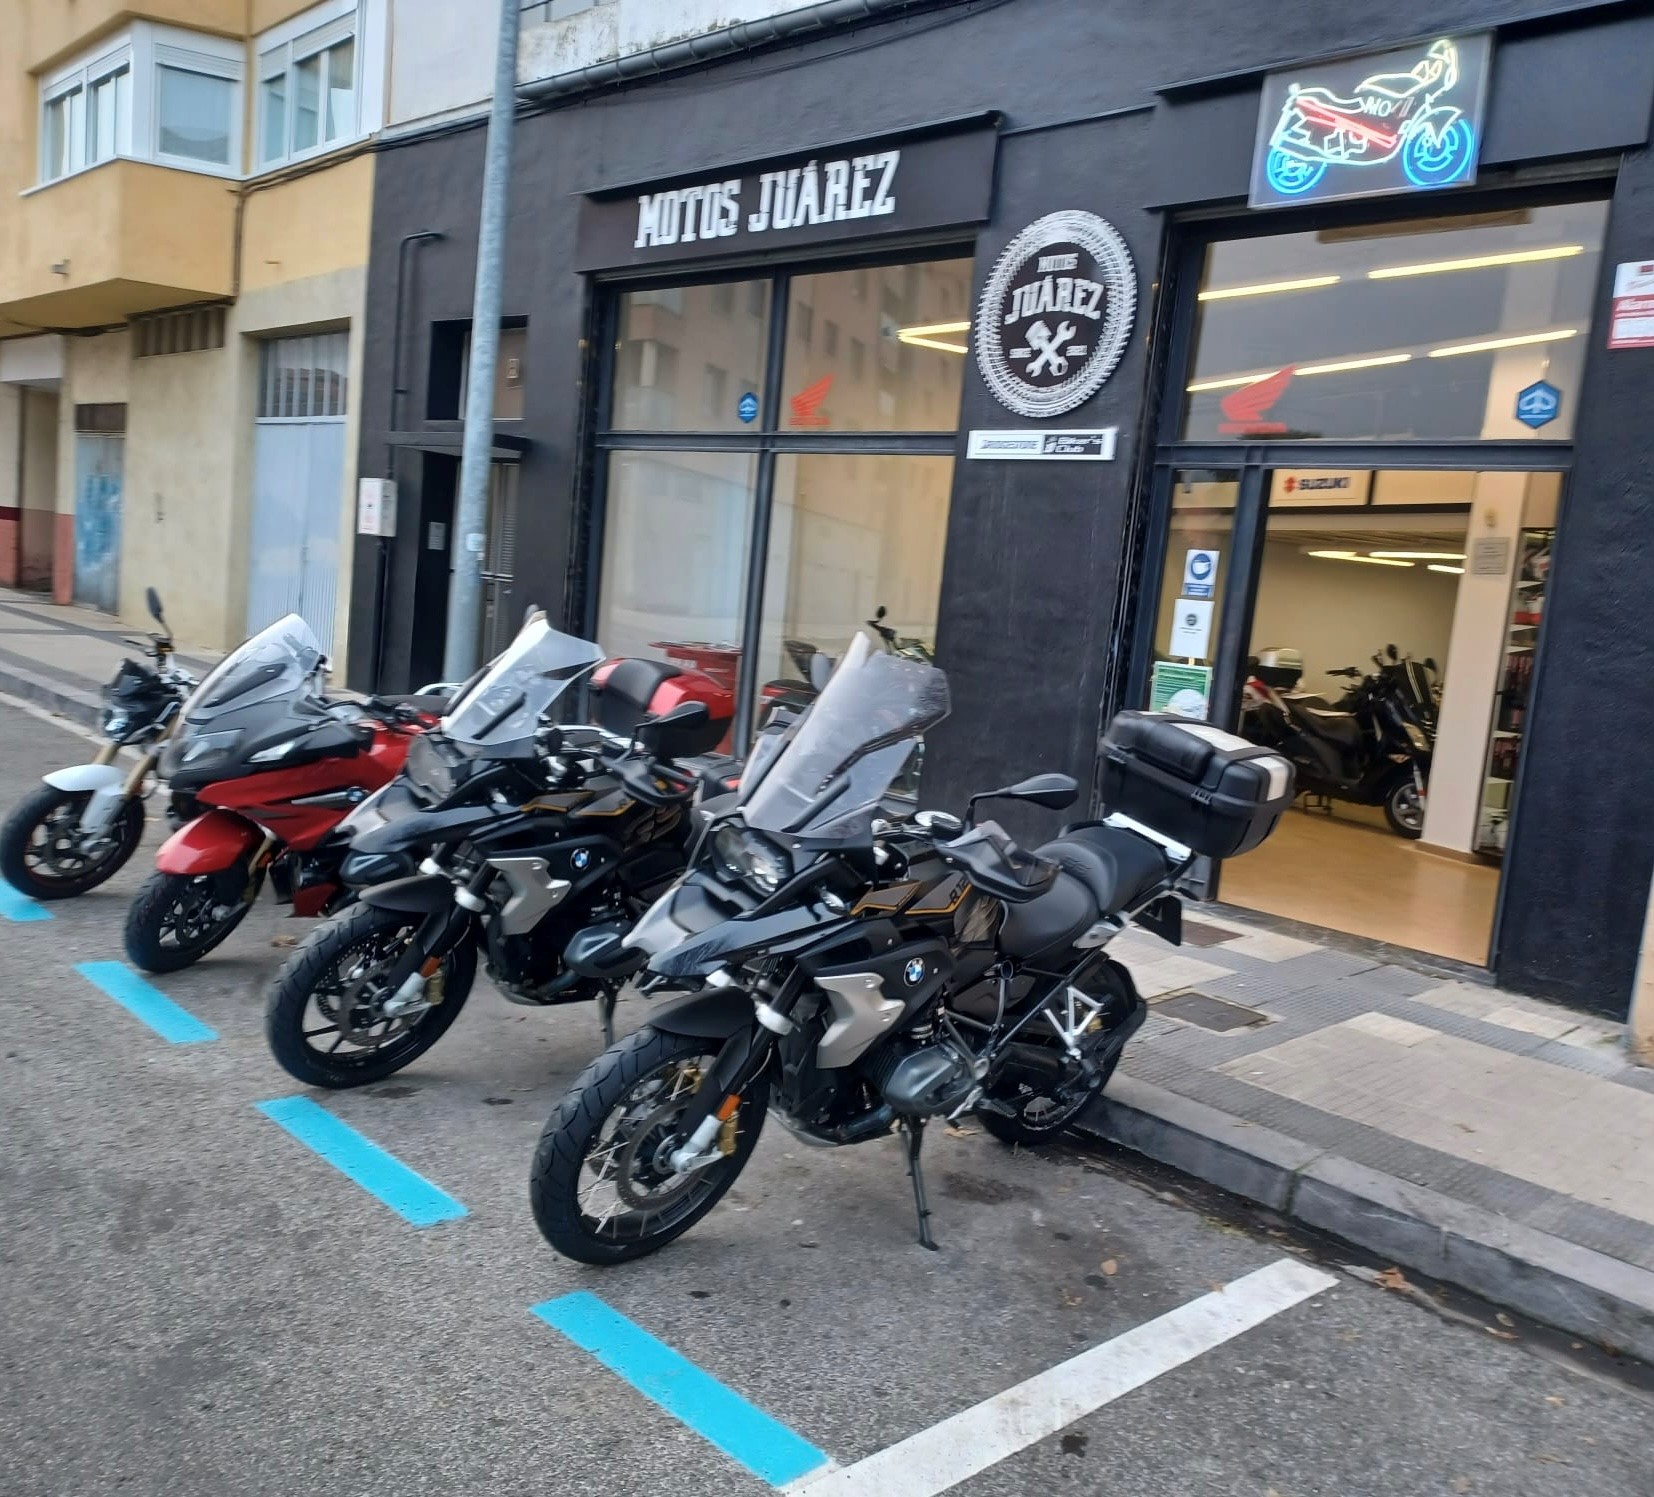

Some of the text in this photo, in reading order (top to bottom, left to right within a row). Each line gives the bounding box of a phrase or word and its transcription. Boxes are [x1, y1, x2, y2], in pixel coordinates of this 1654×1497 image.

[634, 150, 900, 248] MOTOS JUÁREZ
[1004, 274, 1104, 325] JUÁREZ
[1299, 477, 1352, 490] SUZUKI
